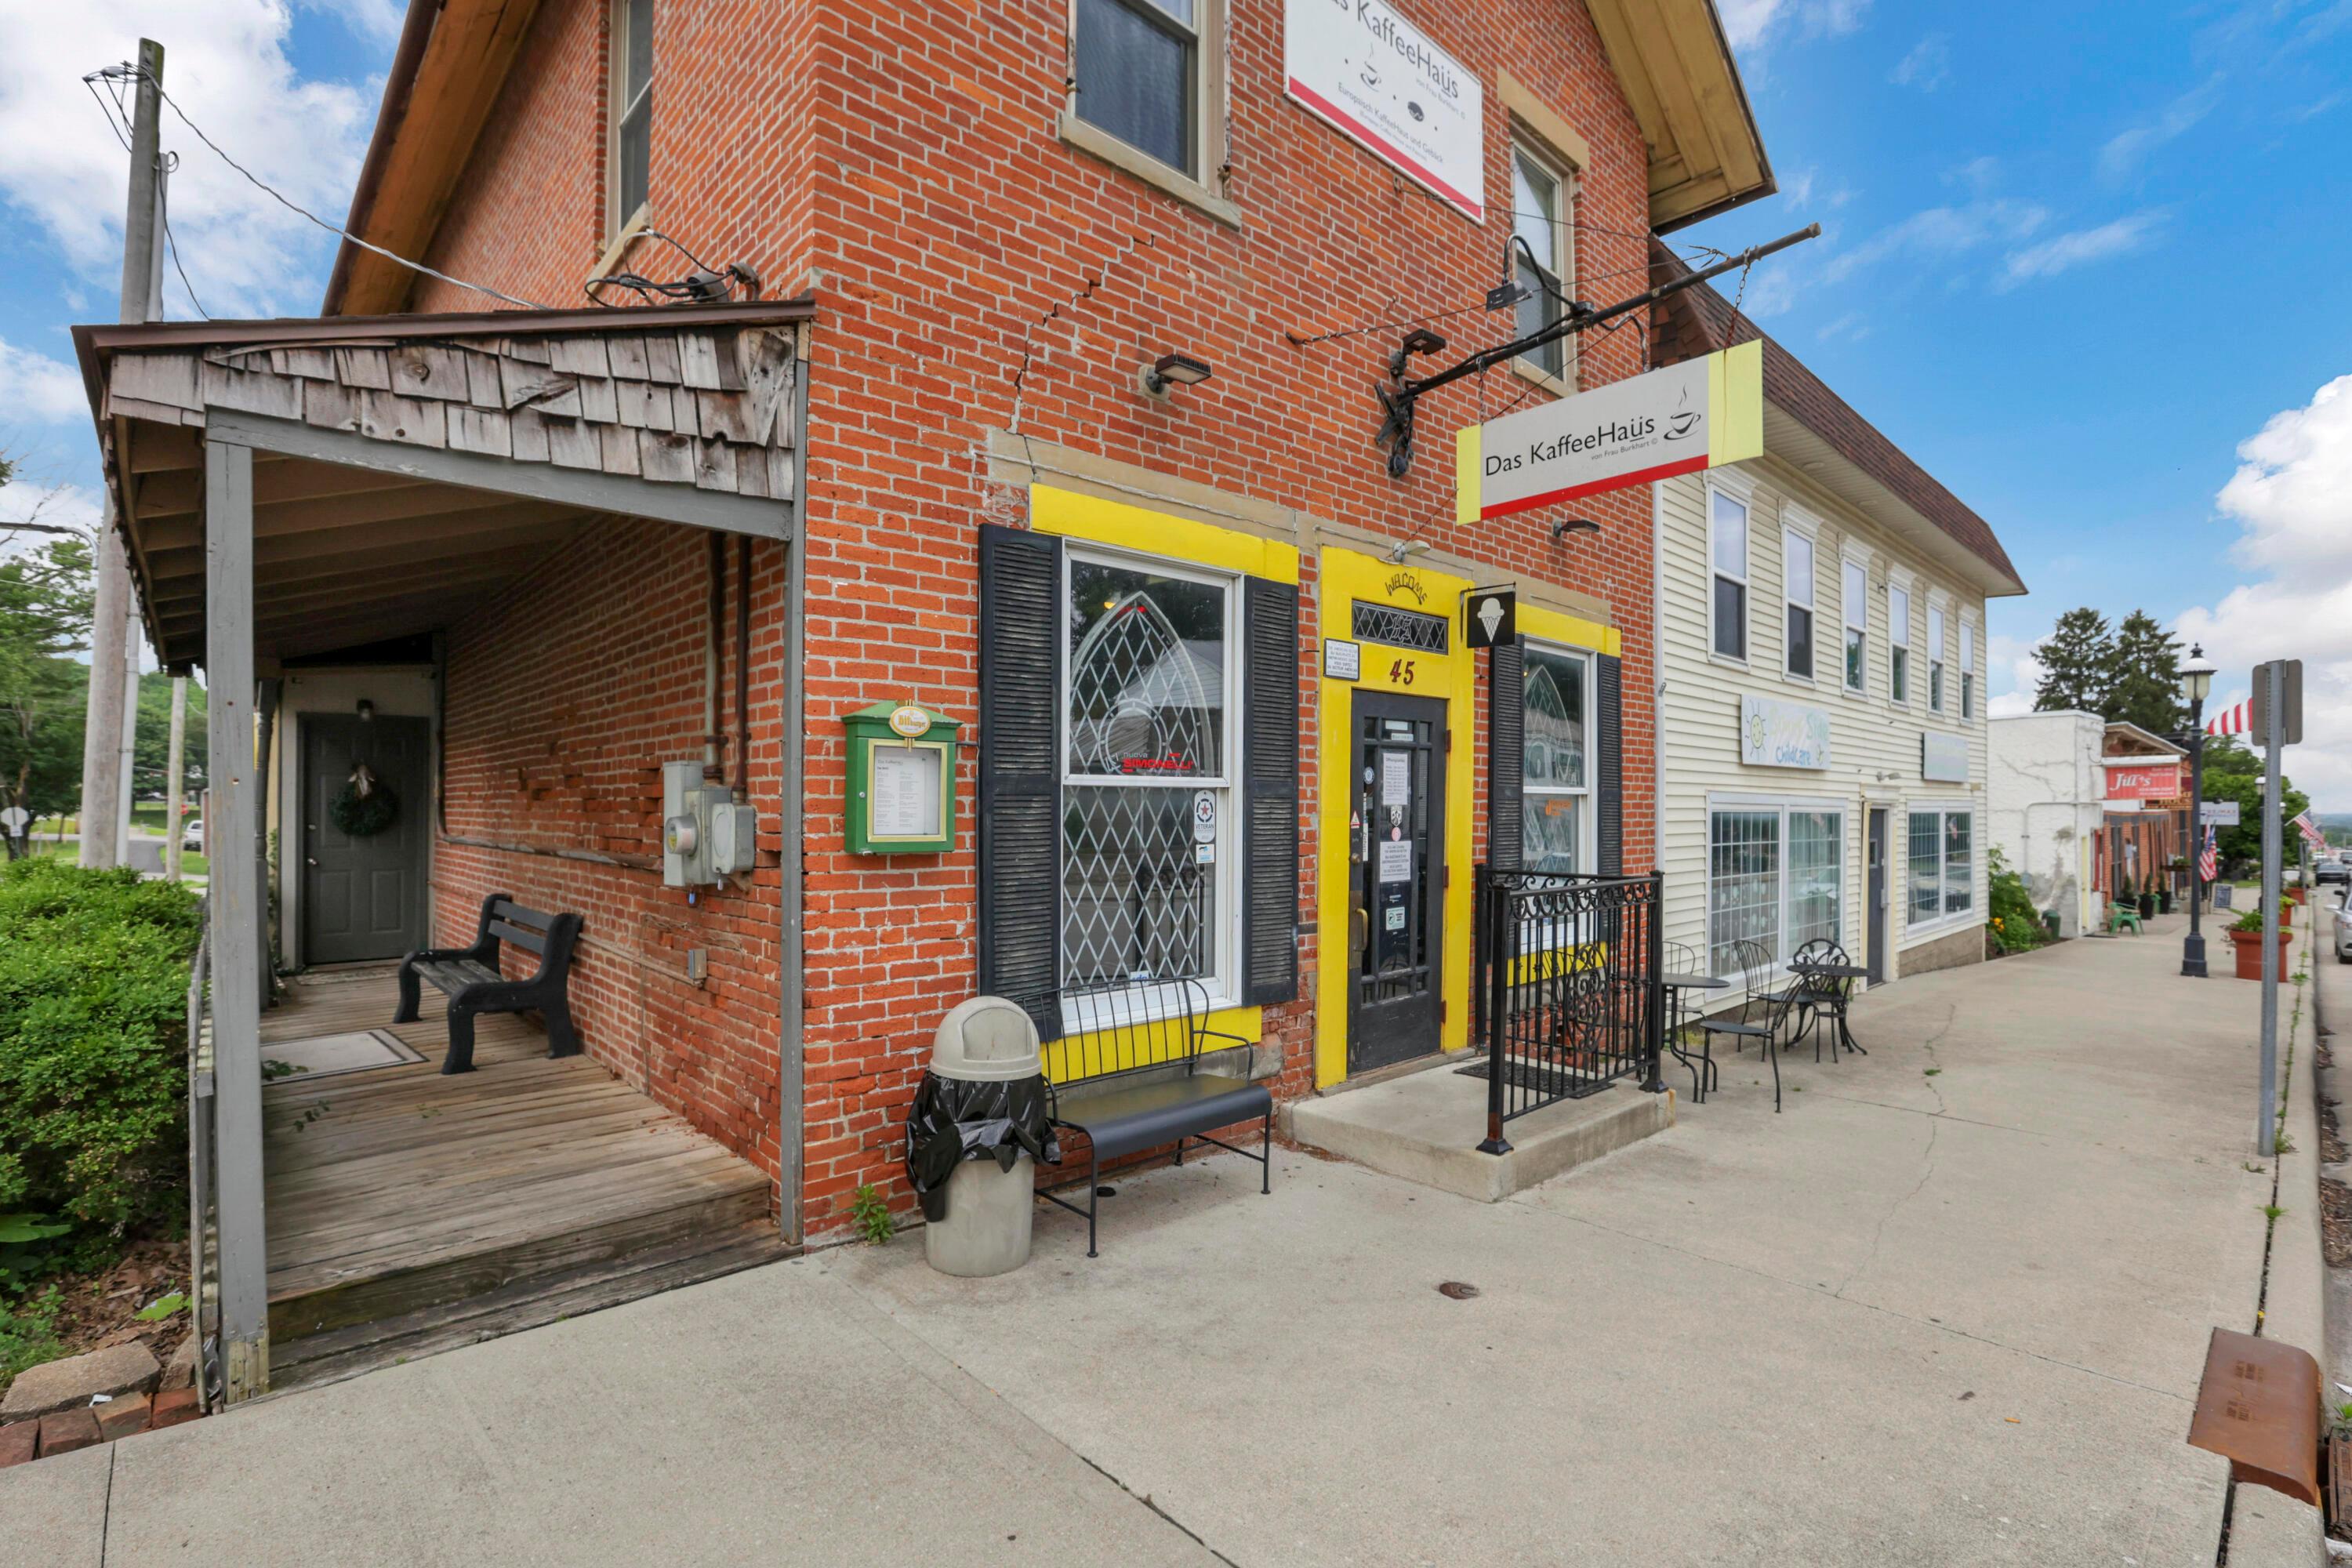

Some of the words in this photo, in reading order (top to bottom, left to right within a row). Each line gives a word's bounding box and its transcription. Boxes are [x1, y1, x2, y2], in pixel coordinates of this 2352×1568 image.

[1486, 453, 1522, 477] Das
[1530, 416, 1656, 465] KaffeeHaüs
[1620, 441, 1650, 453] Burkhart
[1389, 659, 1414, 685] 45
[2109, 773, 2152, 791] Jill's
